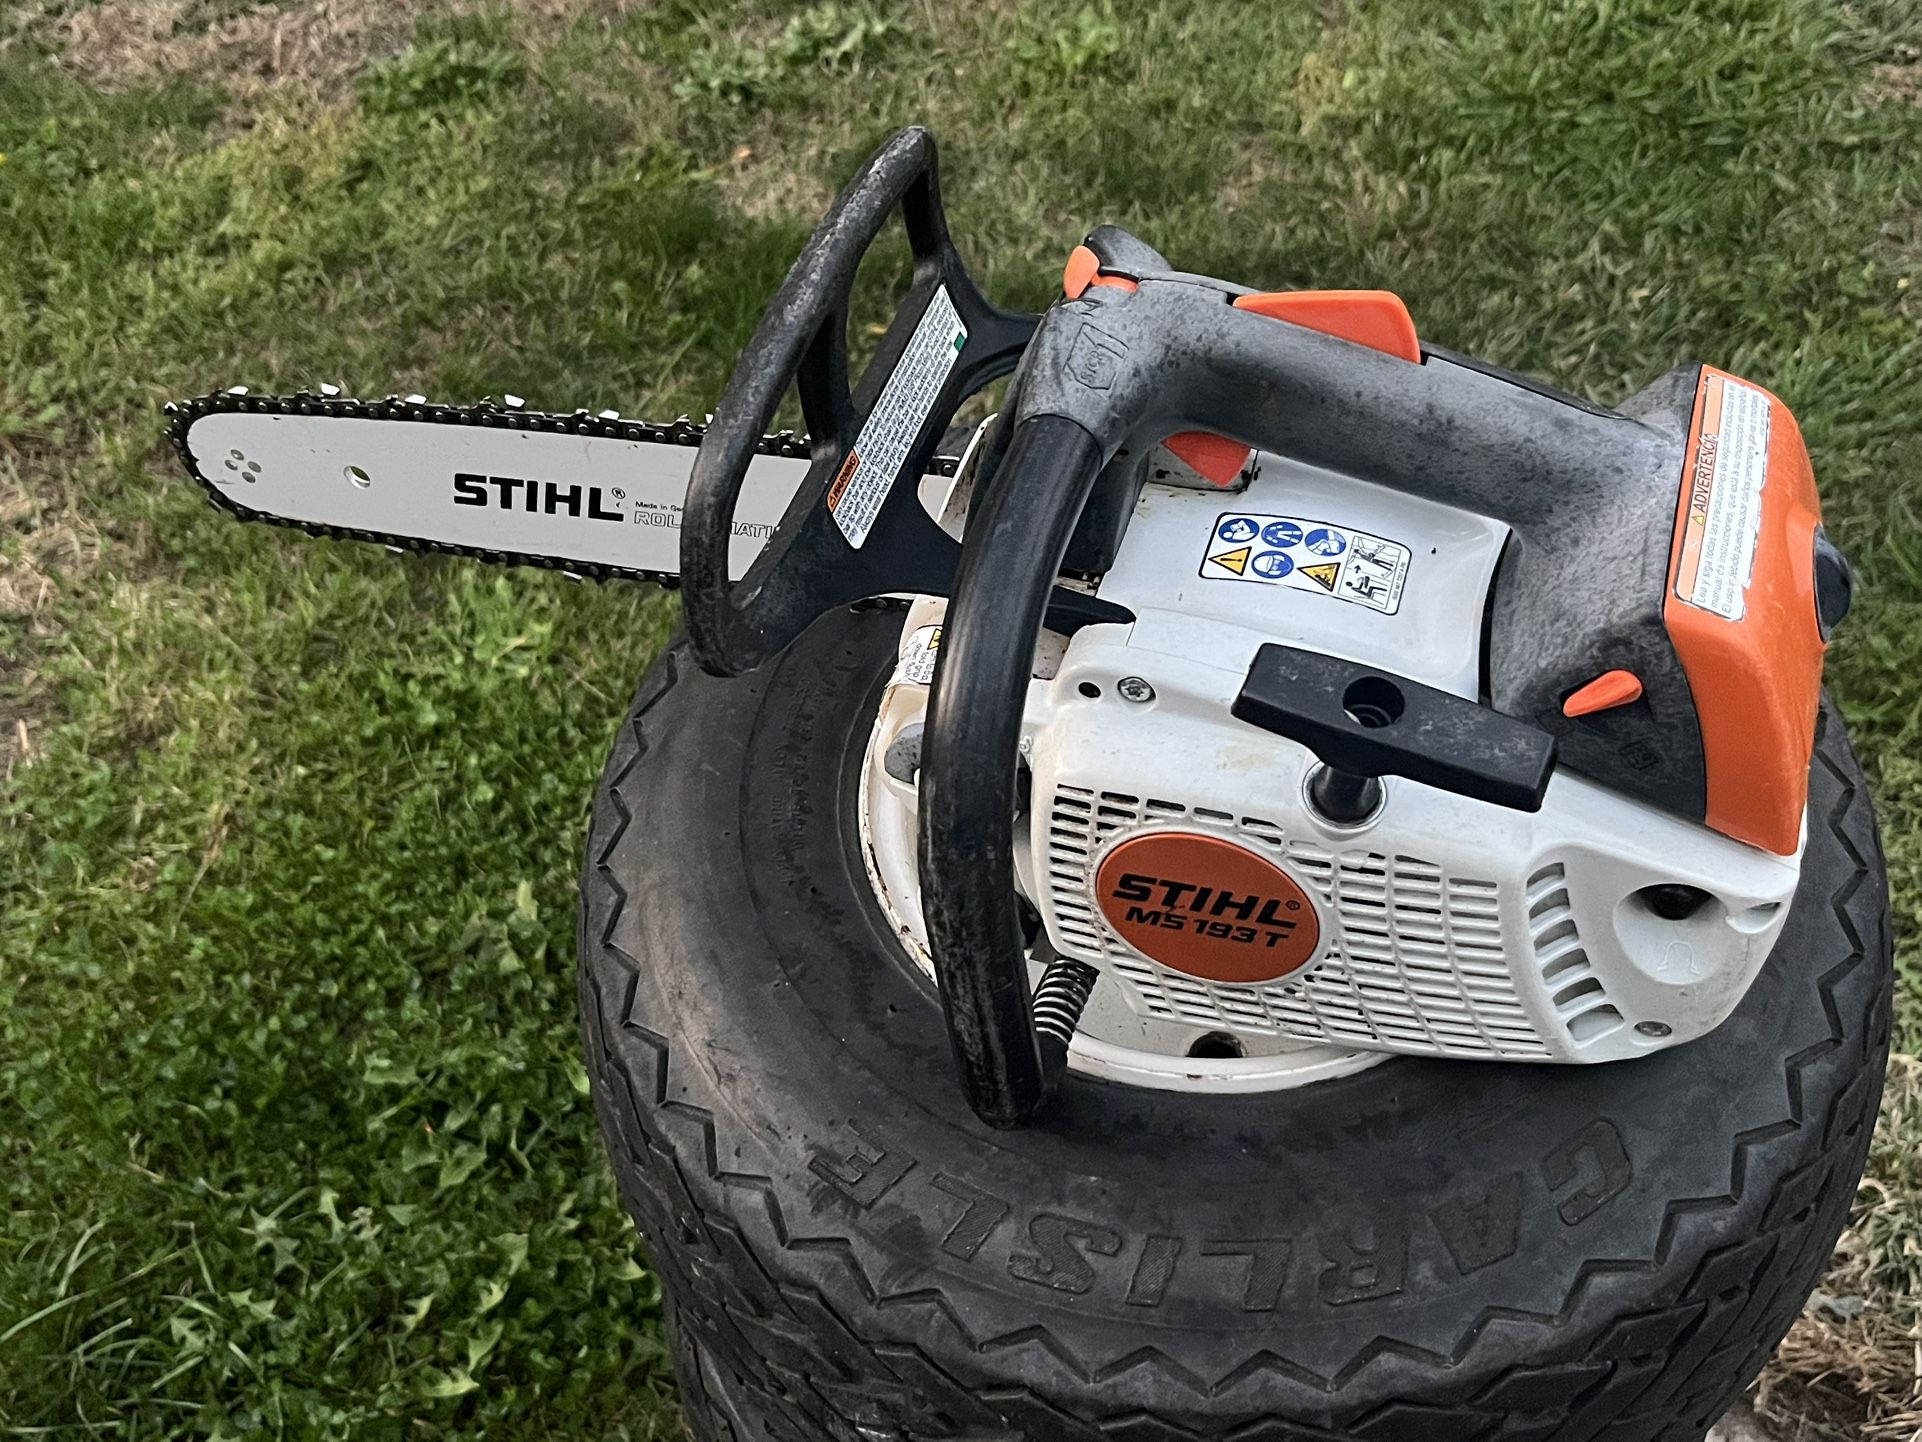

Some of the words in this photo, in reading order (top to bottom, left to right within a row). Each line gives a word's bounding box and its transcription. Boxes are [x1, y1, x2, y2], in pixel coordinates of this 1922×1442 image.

[1693, 433, 1717, 513] ADVERTENCIA
[1718, 460, 1728, 472] de
[832, 454, 857, 499] WARNING
[635, 501, 658, 510] Made
[660, 502, 669, 510] in
[1710, 471, 1726, 522] precauciones
[1738, 502, 1748, 529] causar
[1708, 521, 1719, 536] las
[1704, 535, 1717, 560] todas
[1711, 576, 1723, 609] manual
[1728, 494, 1738, 510] que
[1702, 559, 1714, 579] siga
[1701, 579, 1710, 587] y
[1698, 586, 1709, 605] Lea
[1726, 587, 1734, 604] uso
[1722, 603, 1732, 614] El
[808, 1116, 1633, 1312] CARLISLE
